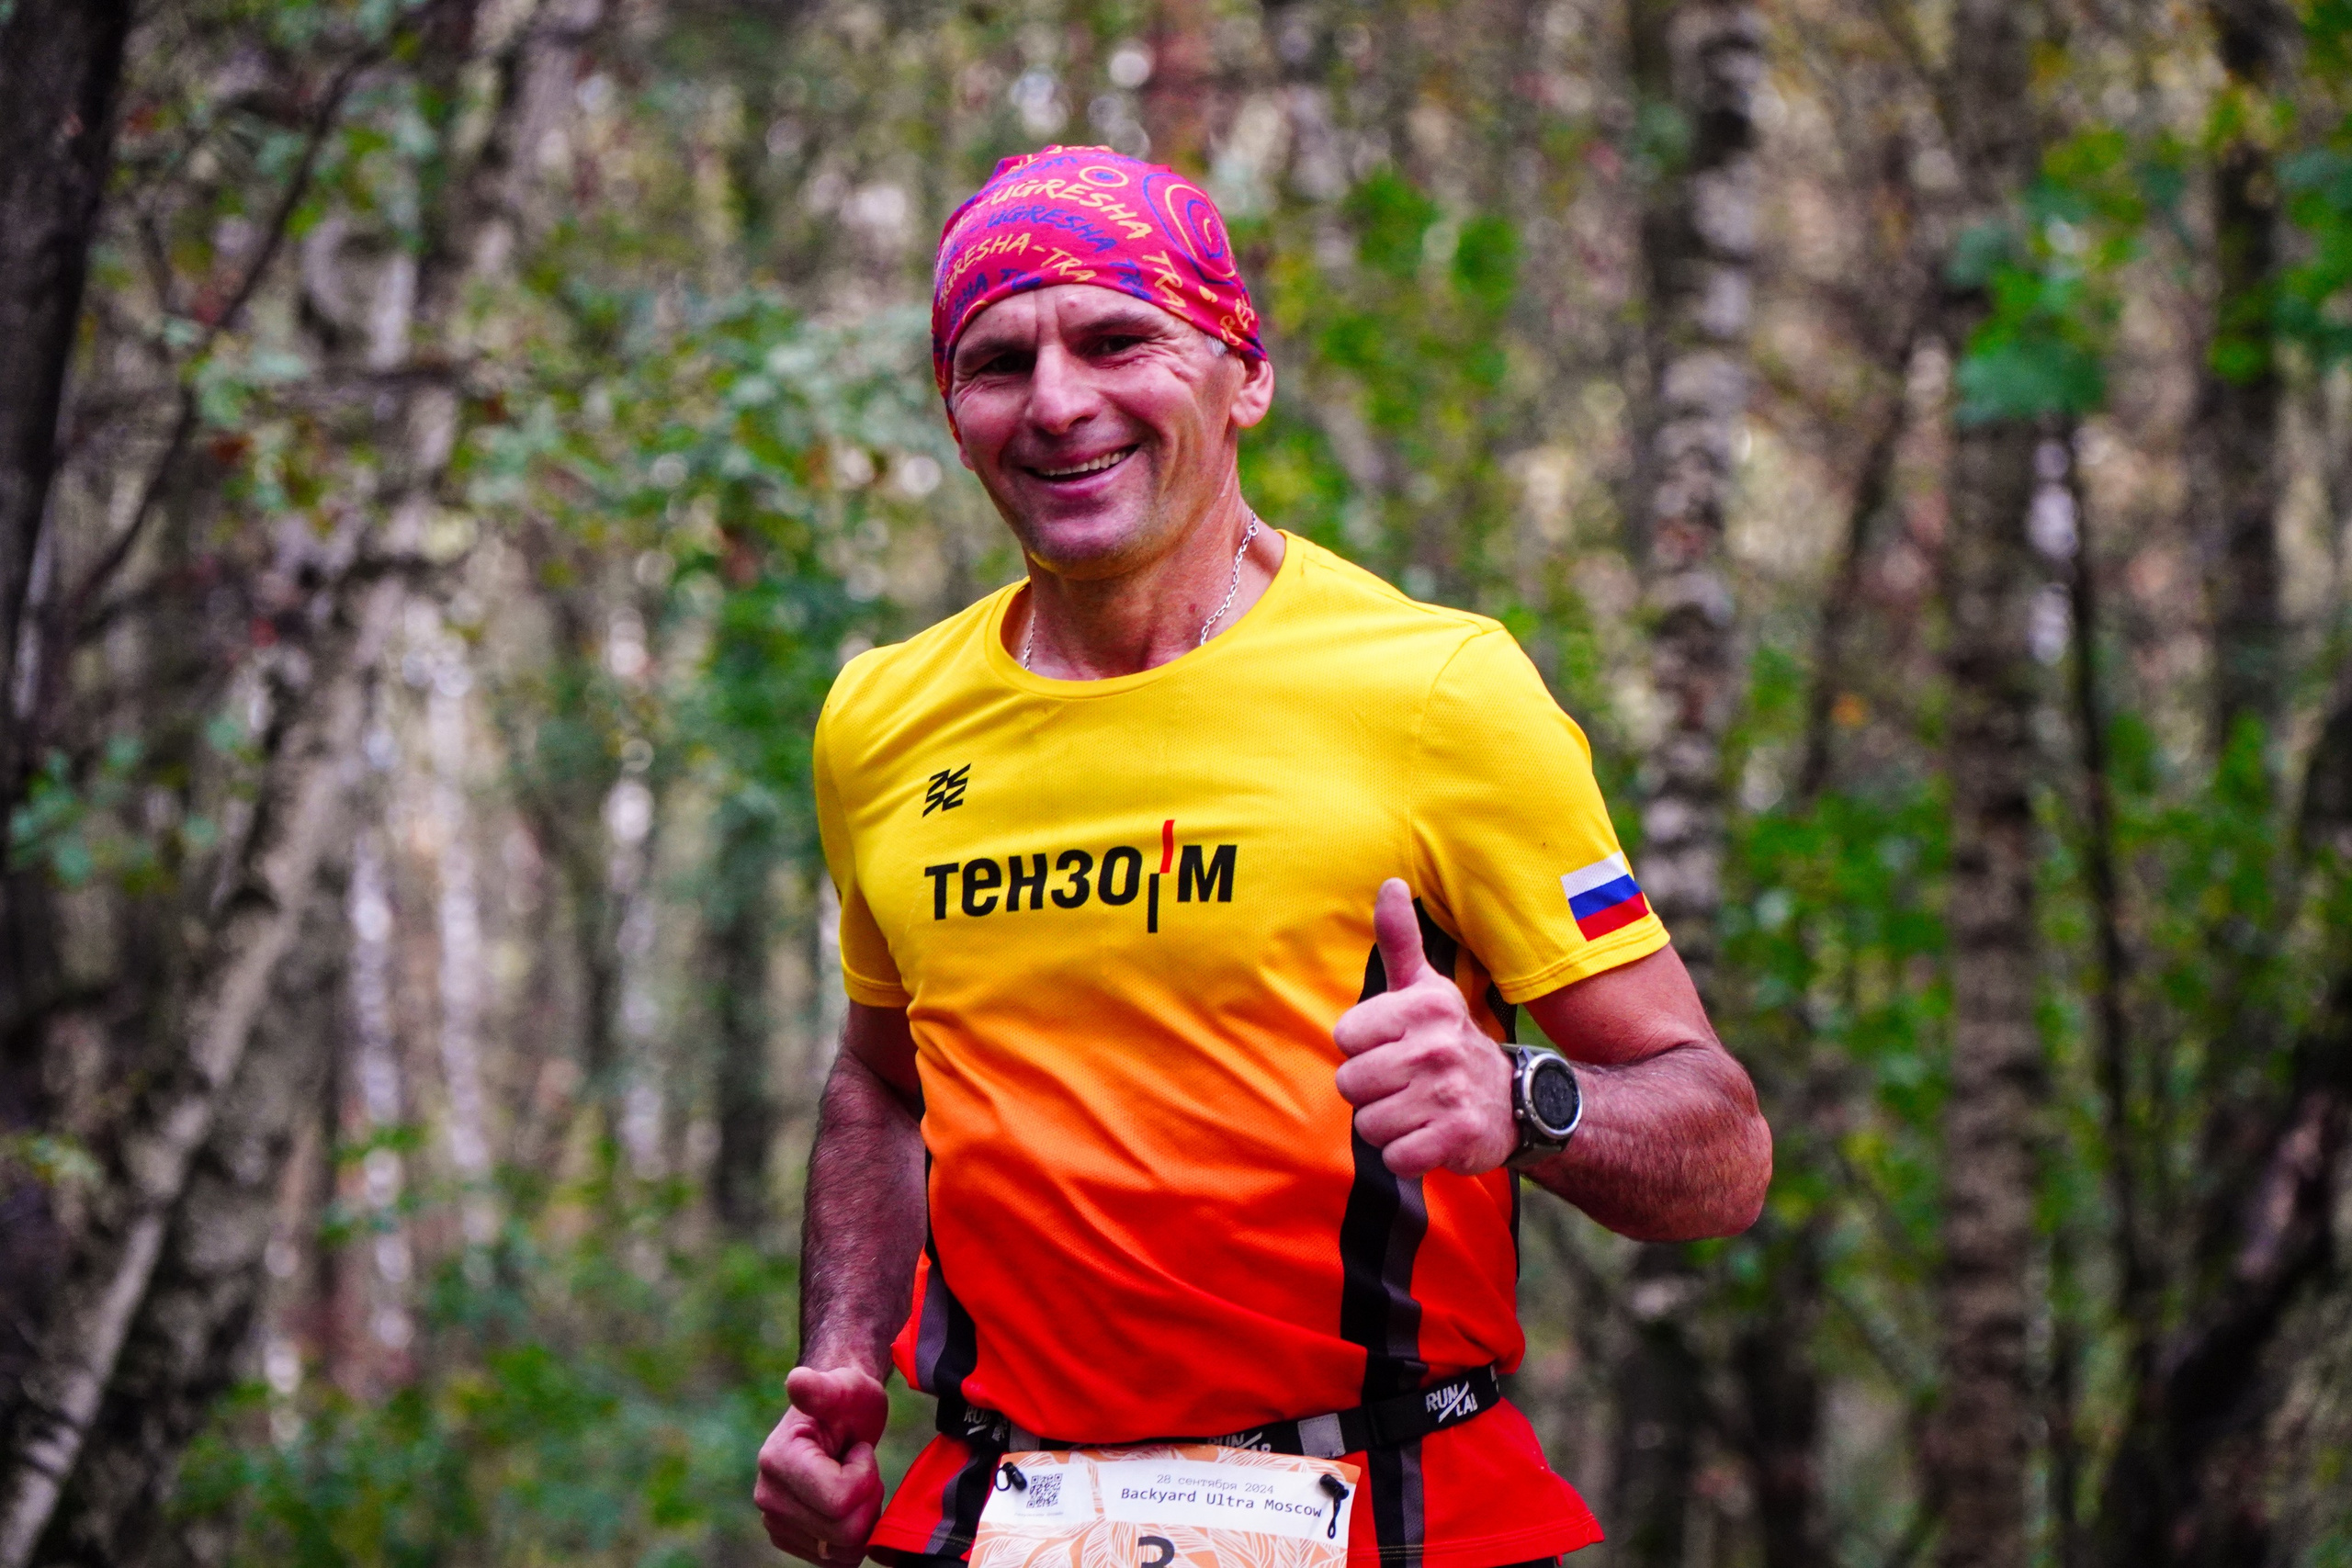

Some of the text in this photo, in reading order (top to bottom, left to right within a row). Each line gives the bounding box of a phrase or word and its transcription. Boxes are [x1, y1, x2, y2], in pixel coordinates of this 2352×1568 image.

[1425, 1383, 1459, 1413] RUN
[1157, 1474, 1274, 1495] 28 сентября 2024
[1121, 1487, 1322, 1517] Backyard Ultra Moscow
